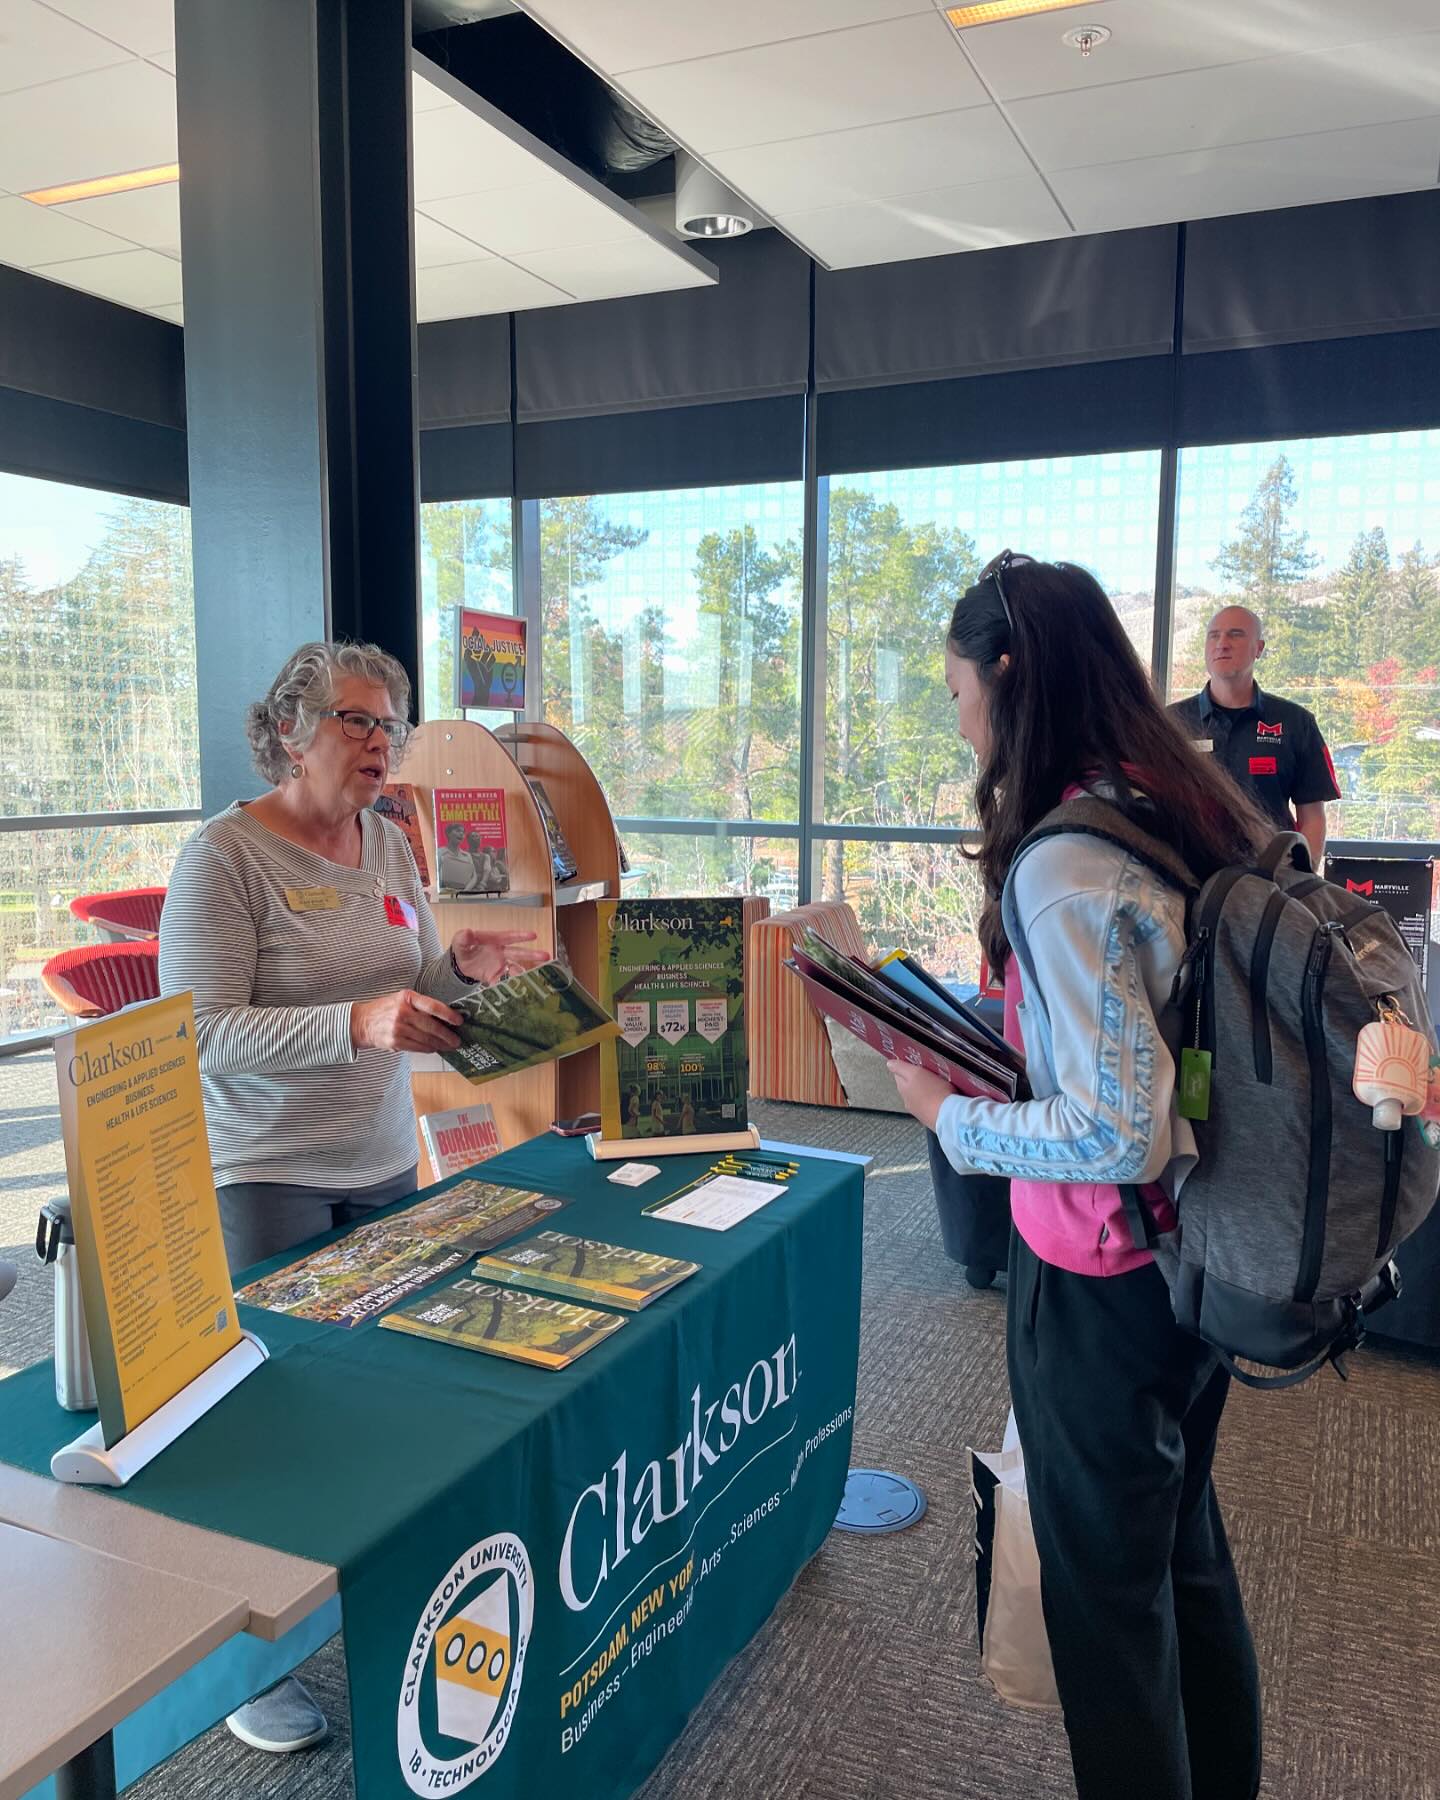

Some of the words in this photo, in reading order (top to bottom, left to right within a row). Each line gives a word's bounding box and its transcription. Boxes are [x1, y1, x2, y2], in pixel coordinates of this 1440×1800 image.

[462, 635, 490, 652] OCIAL
[491, 639, 525, 656] JUSTICE
[440, 809, 479, 821] EMMETT
[483, 809, 500, 821] TILL
[607, 911, 694, 932] Clarkson
[619, 964, 661, 972] ENGINEERING
[661, 963, 666, 971] &
[667, 962, 693, 971] APPLIED
[694, 962, 725, 970] SCIENCES
[634, 982, 660, 990] HEALTH
[666, 981, 679, 989] LIFE
[680, 980, 710, 988] SCIENCES
[657, 972, 688, 980] BUSINESS
[68, 1037, 154, 1087] Clarkson
[646, 1062, 666, 1072] 98%
[680, 1062, 705, 1073] 100%
[86, 1081, 127, 1107] ENGINEERING
[133, 1066, 159, 1085] APPLIED
[159, 1055, 186, 1074] SCIENCES
[125, 1084, 155, 1105] BUSINESS
[106, 1110, 130, 1130] HEALTH
[135, 1101, 149, 1116] LIFE
[149, 1089, 178, 1109] SCIENCES
[436, 1119, 499, 1157] BURNING
[537, 1230, 698, 1276] Clarkson
[337, 1282, 394, 1316] ADVENTURE
[364, 1281, 416, 1311] CLARKSON
[411, 1251, 463, 1284] UNIVERSITY
[451, 1278, 626, 1331] Clarkson
[558, 1332, 798, 1612] Clarkson
[561, 1674, 621, 1754] Business
[700, 1547, 721, 1580] Arts
[730, 1491, 780, 1544] Sciences
[804, 1405, 852, 1459] Professions
[404, 1566, 465, 1707] CLARKSON
[470, 1542, 527, 1589] UNIVERSITY
[560, 1622, 629, 1719] POTSDAM,
[631, 1584, 665, 1633] NEW
[669, 1549, 695, 1599] YOR
[408, 1748, 422, 1774] 18
